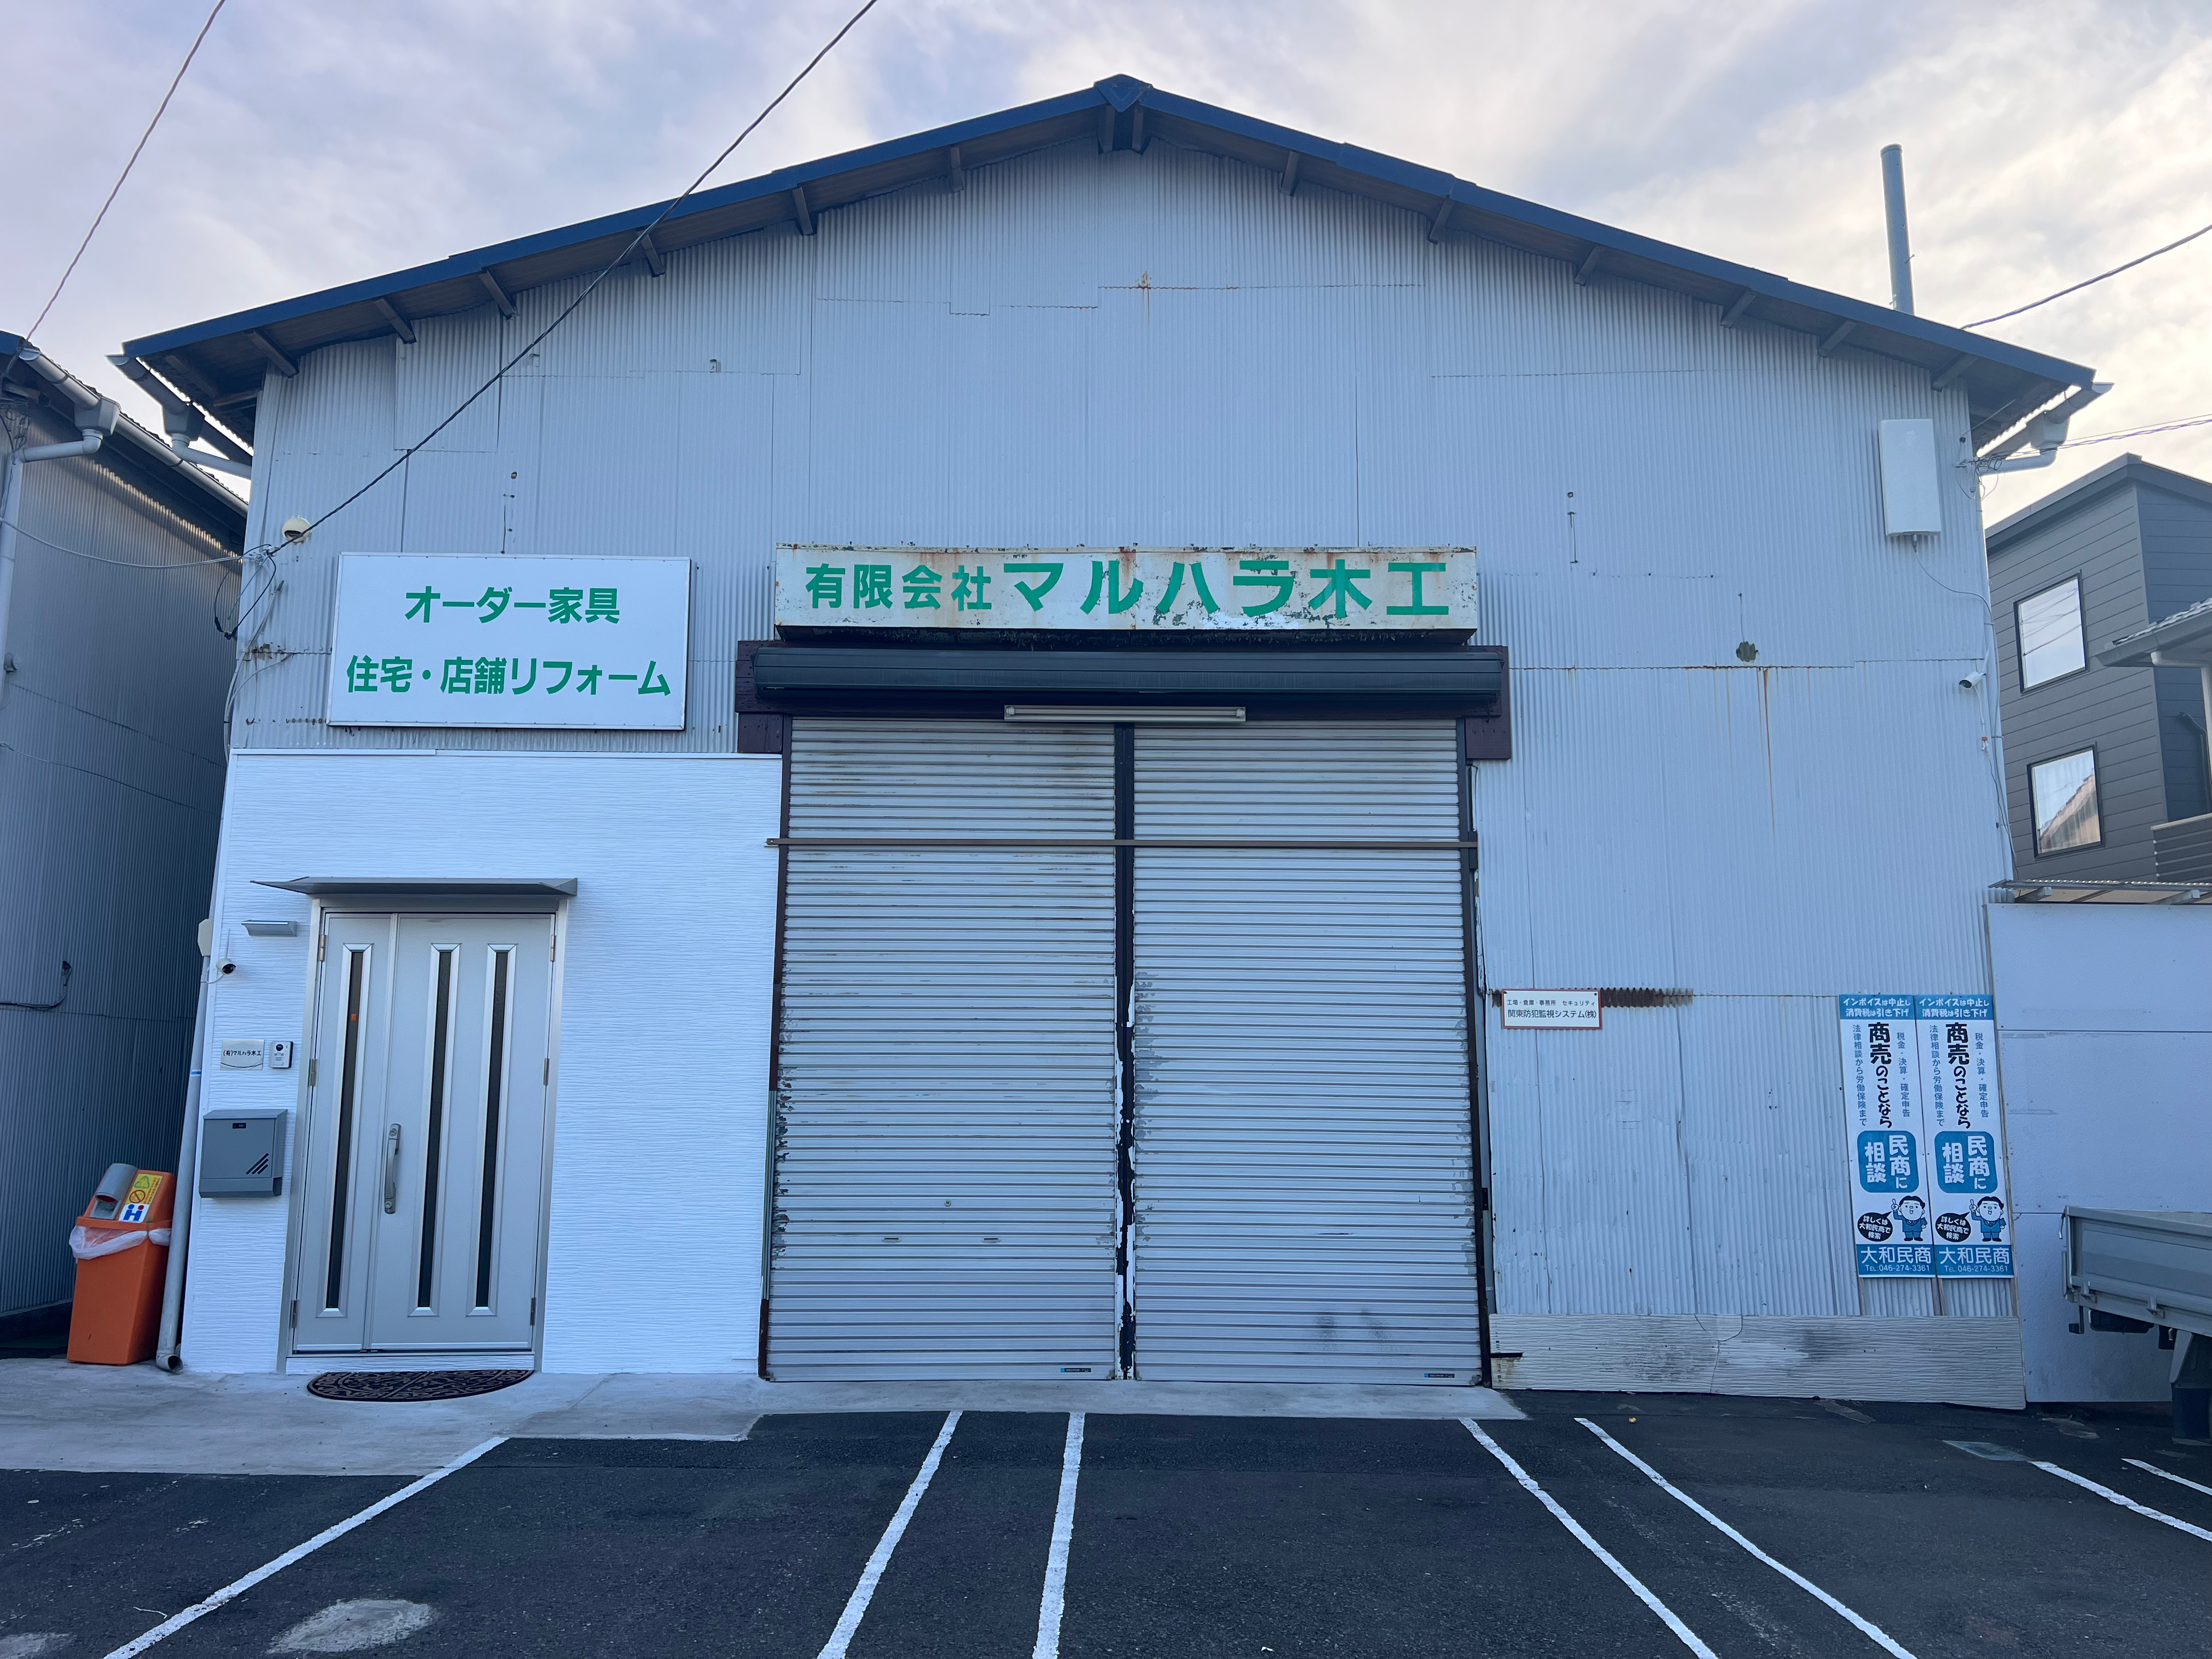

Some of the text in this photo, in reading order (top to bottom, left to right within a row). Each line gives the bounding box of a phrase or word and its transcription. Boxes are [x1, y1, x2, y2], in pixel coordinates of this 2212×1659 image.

[805, 559, 1449, 618] 有限会社マルハラ木工
[404, 585, 620, 624] オーダー家具
[346, 654, 671, 696] 住宅・店舗リフォーム
[1508, 1009, 1597, 1019] 関東防犯監視システム(株)
[1843, 997, 1911, 1007] インボイスは中止し
[1846, 1008, 1909, 1017] 消費税は引き下げ
[1919, 997, 1990, 1007] インボイスは中止し
[1922, 1008, 1988, 1018] 消費税は引き下げ
[1853, 1024, 1867, 1126] 法律相談から労働保険まで
[1868, 1022, 1892, 1128] 商売のことなら
[1897, 1032, 1911, 1117] 税金・決算・確定申告
[1929, 1025, 1945, 1126] 法律相談から労働保険まで
[1945, 1022, 1971, 1129] 商売のことなら
[1975, 1032, 1989, 1118] 税金・決算・確定申告
[1864, 1142, 1887, 1183] 相談
[1889, 1135, 1911, 1189] 民商に
[1942, 1142, 1965, 1184] 相談
[1967, 1135, 1990, 1190] 民商に
[1859, 1223, 1891, 1233] 大和民商で
[1863, 1215, 1888, 1225] 詳しくは
[1937, 1223, 1970, 1234] 大和民商で
[1940, 1216, 1966, 1226] 詳しくは
[1867, 1231, 1882, 1240] 検索
[1946, 1232, 1959, 1240] 検索
[1860, 1246, 1932, 1264] 大和民商
[1939, 1247, 2010, 1265] 大和民商
